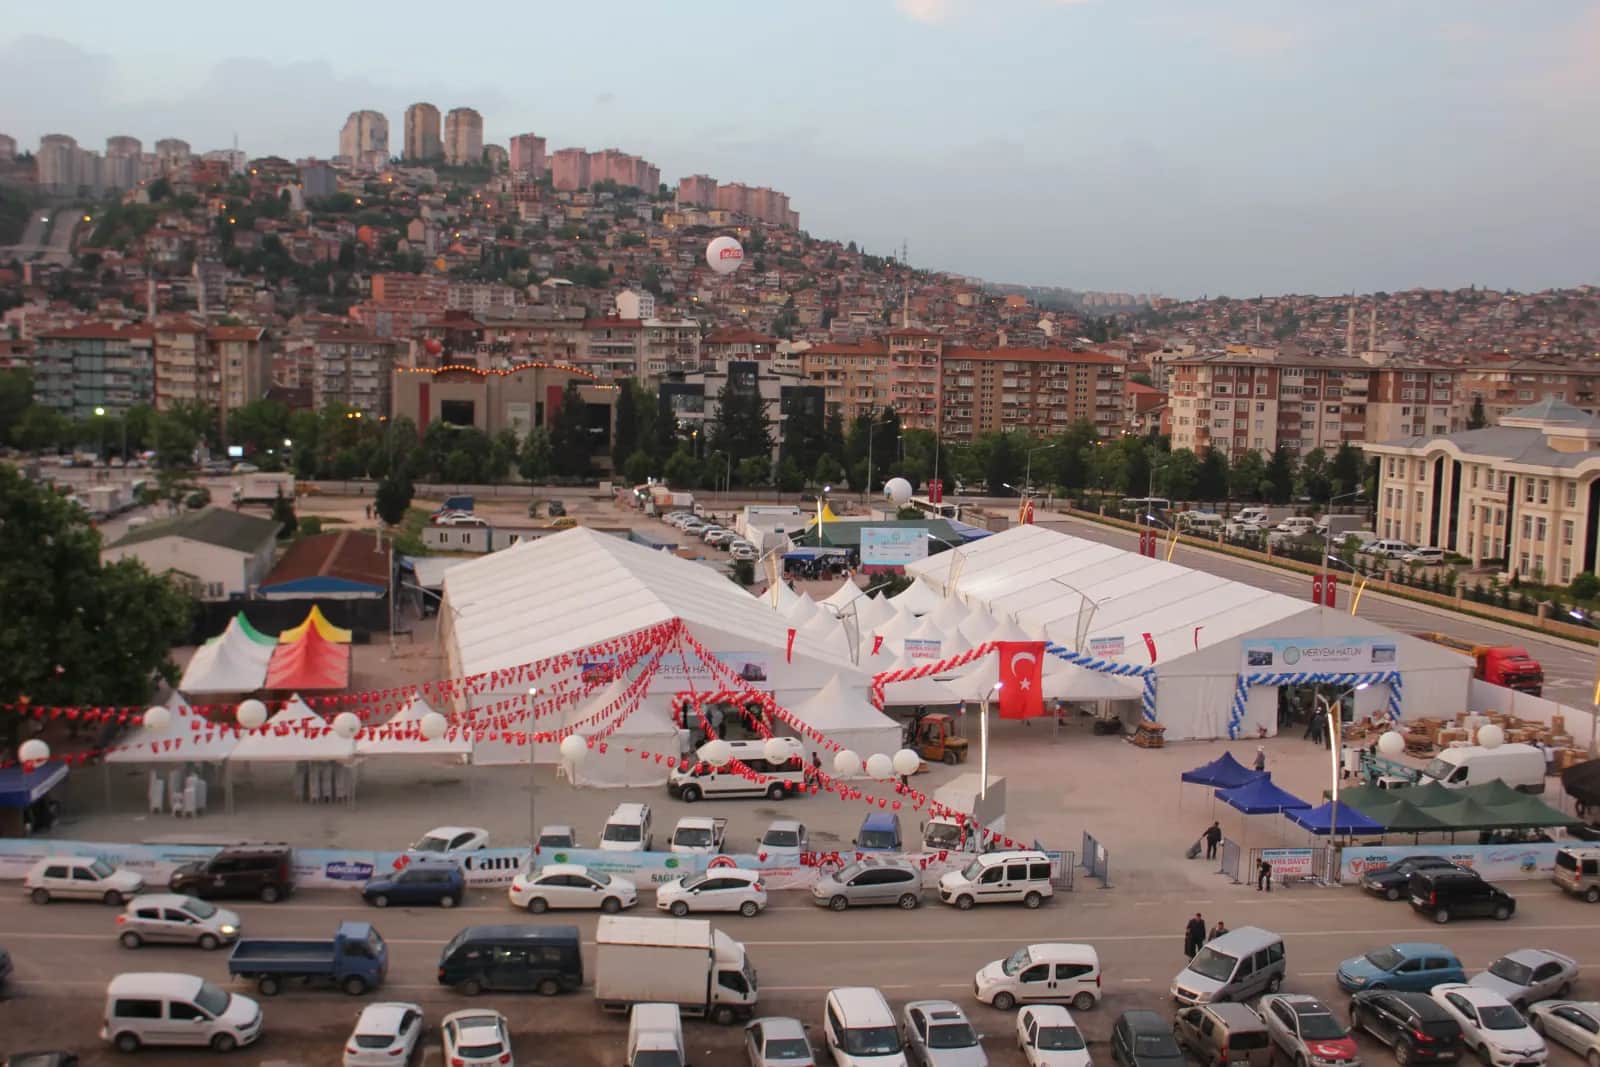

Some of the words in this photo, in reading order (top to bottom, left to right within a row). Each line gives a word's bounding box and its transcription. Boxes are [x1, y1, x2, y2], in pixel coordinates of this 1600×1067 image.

[1302, 647, 1337, 657] MERYEM
[1338, 647, 1362, 656] HATUN
[656, 664, 691, 674] ERYEM
[464, 855, 519, 871] Cam
